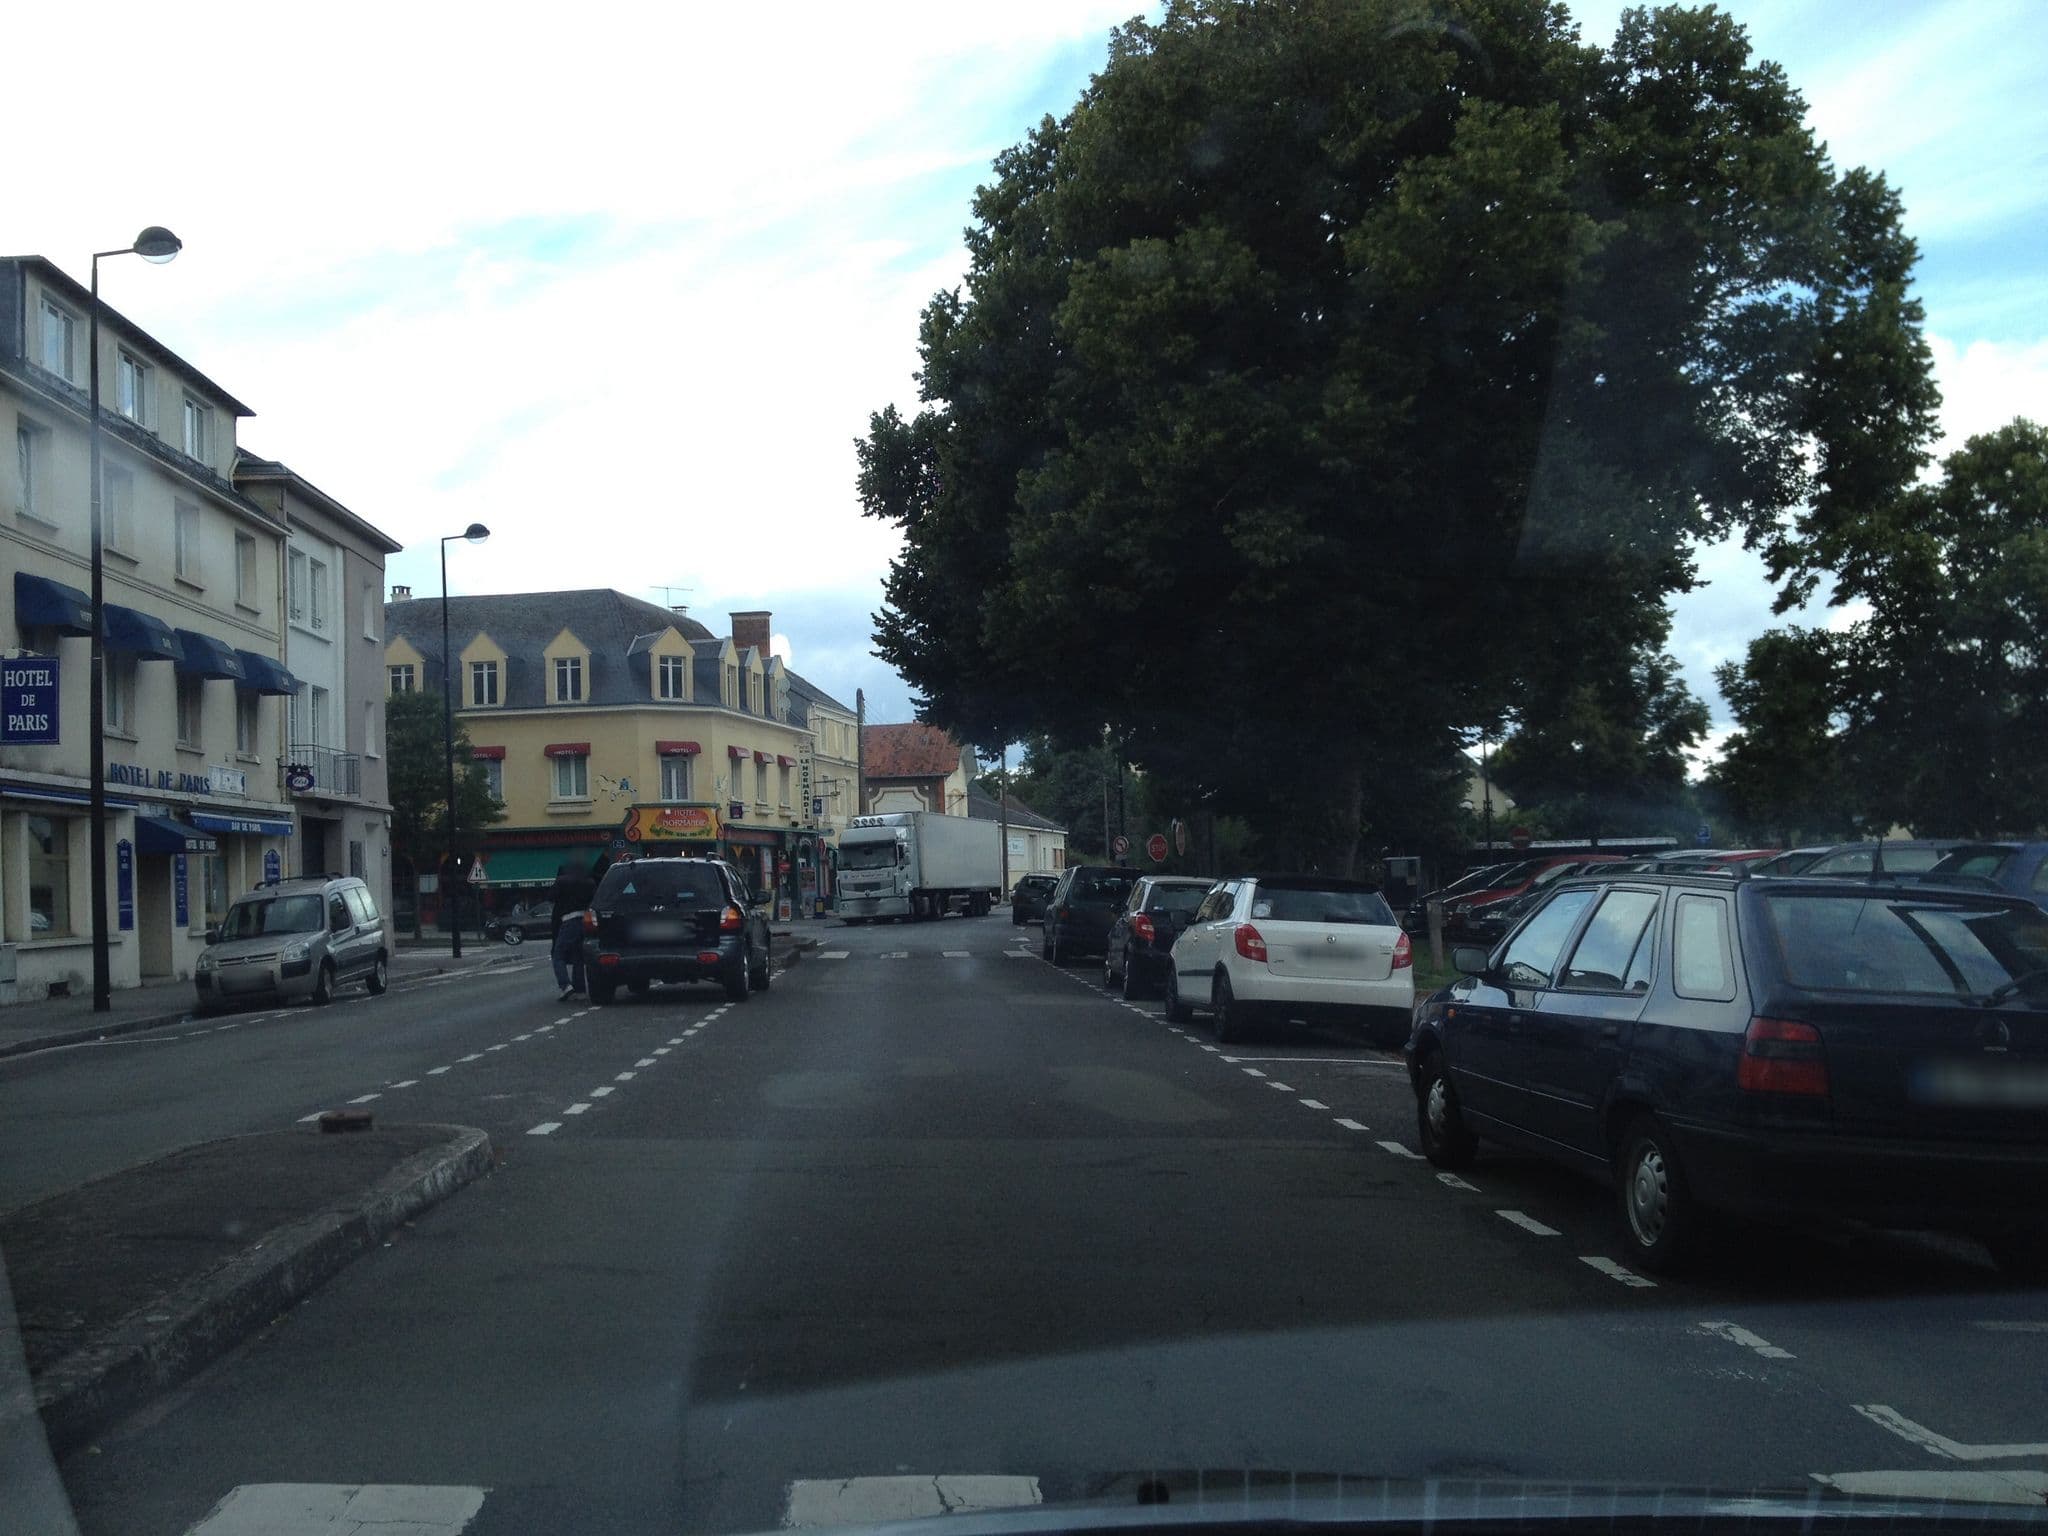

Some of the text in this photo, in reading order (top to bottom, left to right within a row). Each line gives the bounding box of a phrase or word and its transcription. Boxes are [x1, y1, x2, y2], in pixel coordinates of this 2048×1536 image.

[4, 670, 53, 687] HOTEL
[21, 694, 36, 707] DE
[8, 714, 48, 731] PARIS
[110, 763, 153, 789] HOTEL
[158, 770, 173, 791] DE
[180, 773, 210, 795] PARIS
[802, 766, 810, 819] NORMANDIE
[1151, 843, 1167, 852] STOP
